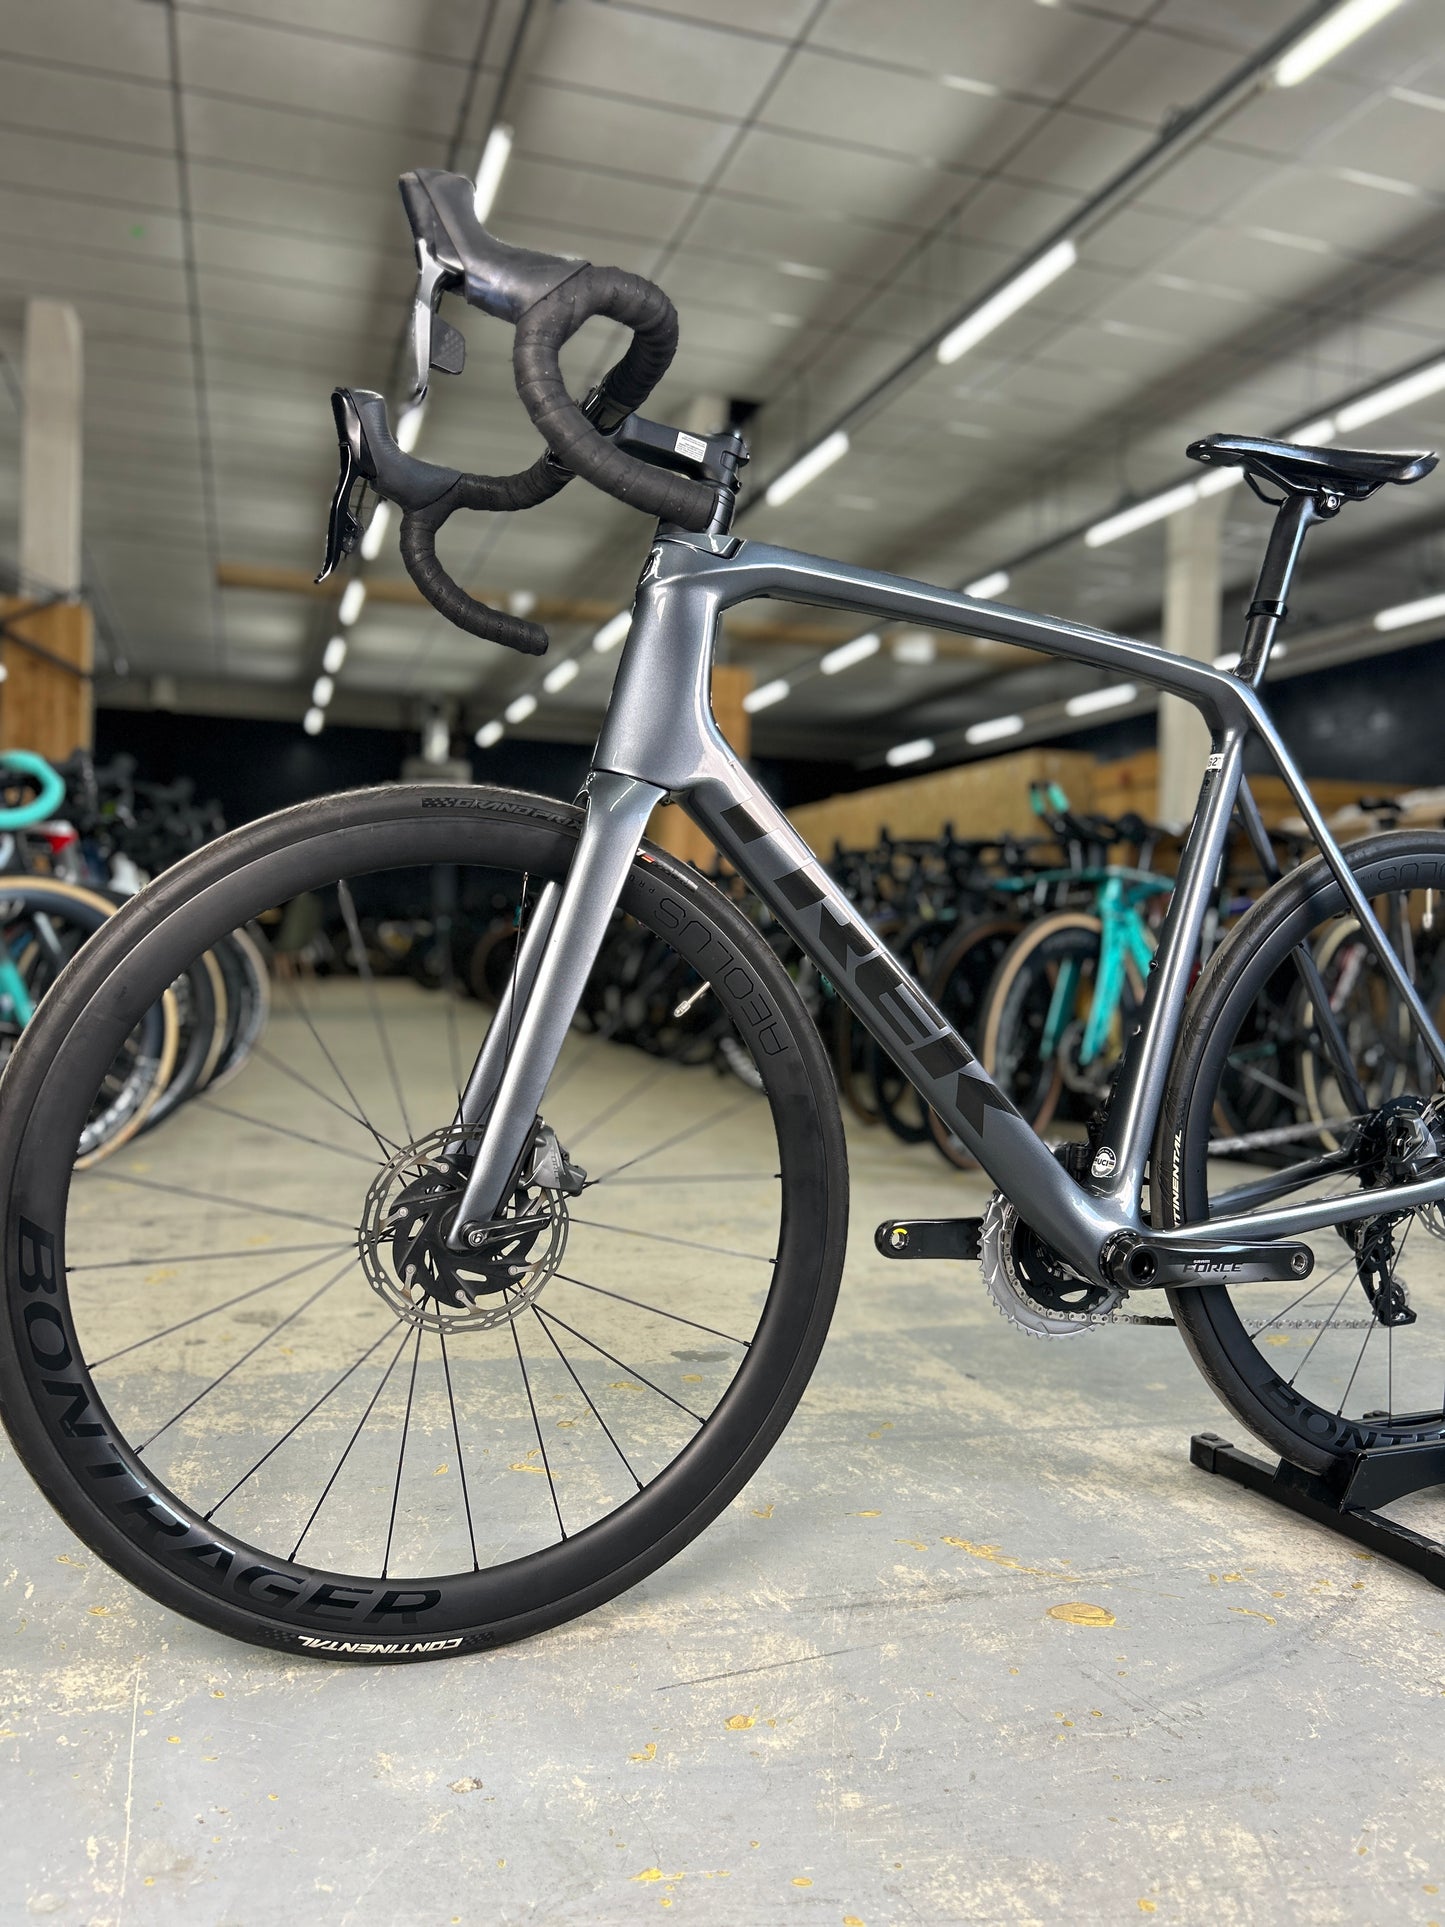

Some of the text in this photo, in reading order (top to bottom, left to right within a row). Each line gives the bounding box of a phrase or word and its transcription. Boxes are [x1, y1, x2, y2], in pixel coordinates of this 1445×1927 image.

[454, 798, 534, 816] GRAND
[655, 898, 788, 1055] AEOLUS
[720, 759, 1023, 1138] TREK
[1183, 1263, 1242, 1273] FORCE
[17, 1215, 443, 1625] BONTRAGER
[298, 1635, 464, 1654] CONTINENTAL
